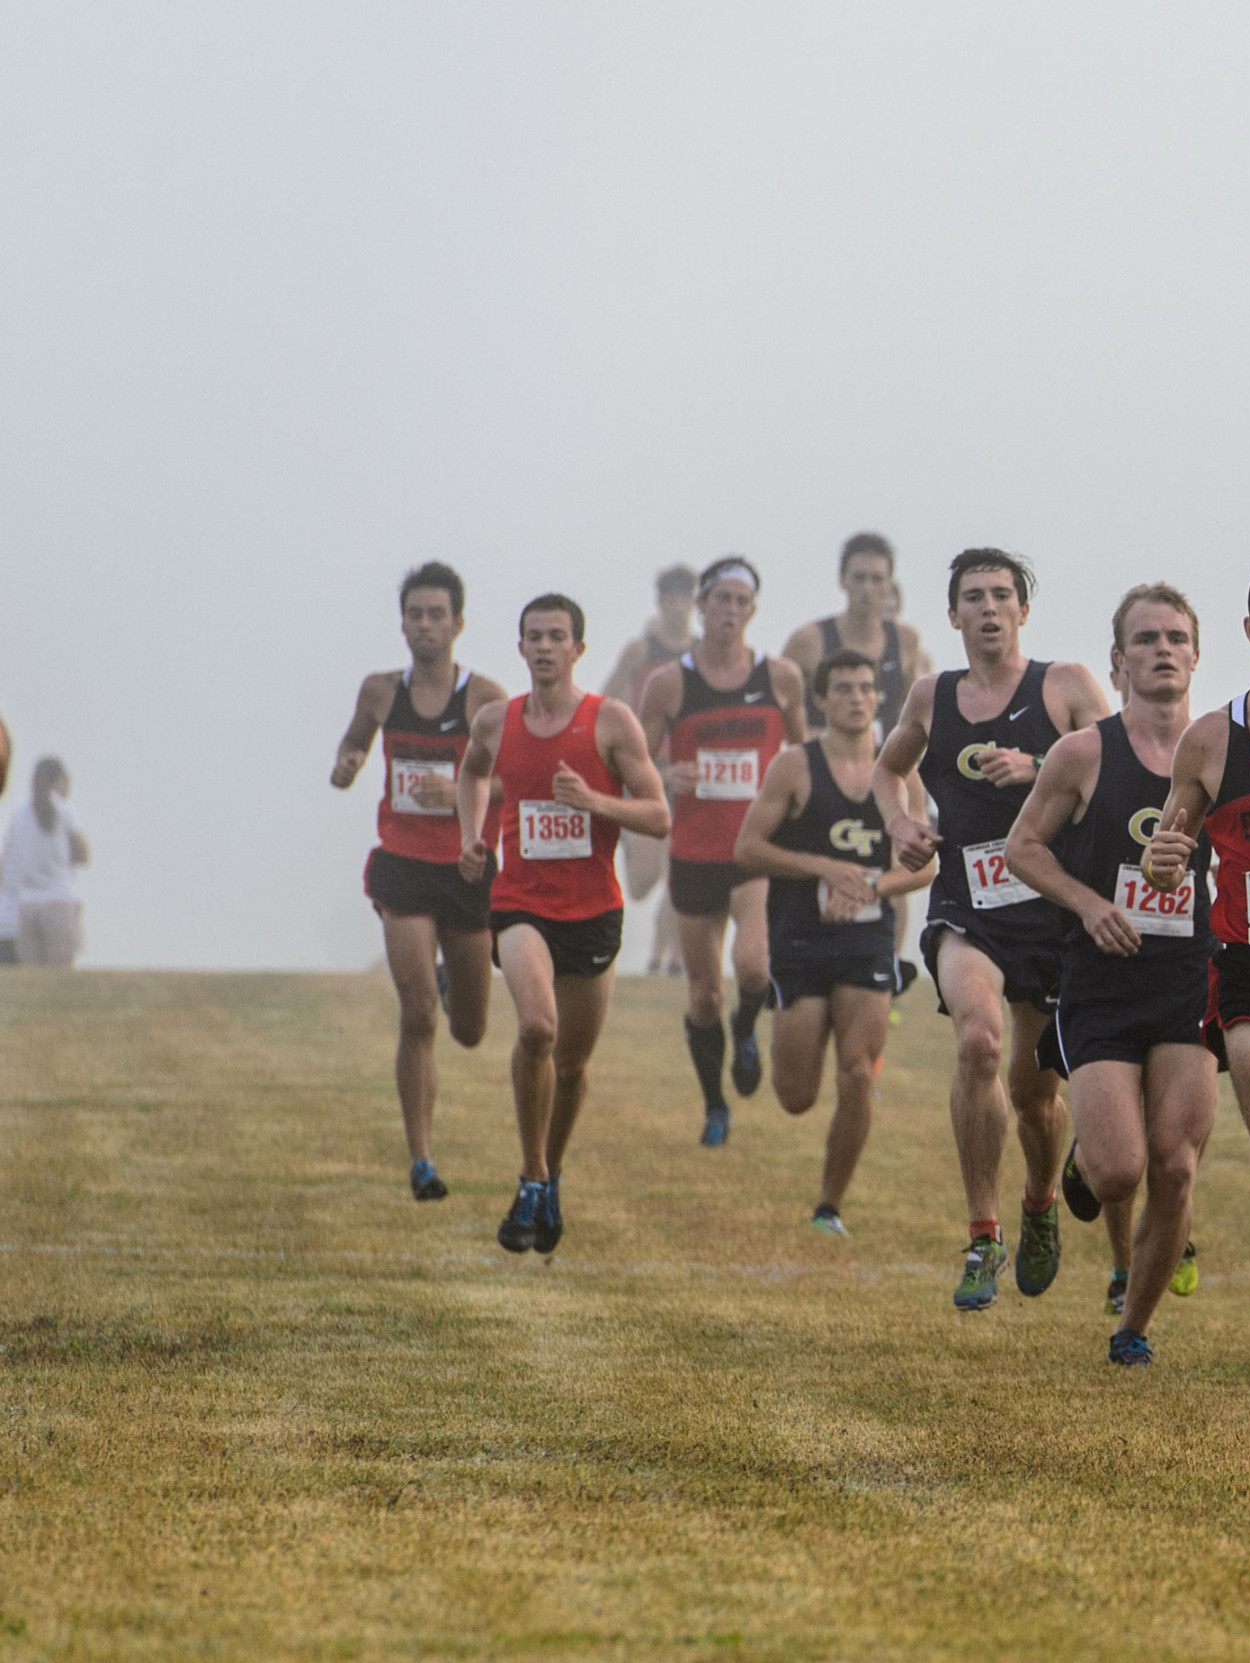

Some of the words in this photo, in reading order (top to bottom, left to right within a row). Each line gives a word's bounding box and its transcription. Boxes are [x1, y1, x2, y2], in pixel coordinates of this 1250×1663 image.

[703, 762, 753, 784] 1218
[525, 814, 585, 841] 1358
[972, 855, 1012, 889] 12
[1124, 880, 1192, 915] 1262
